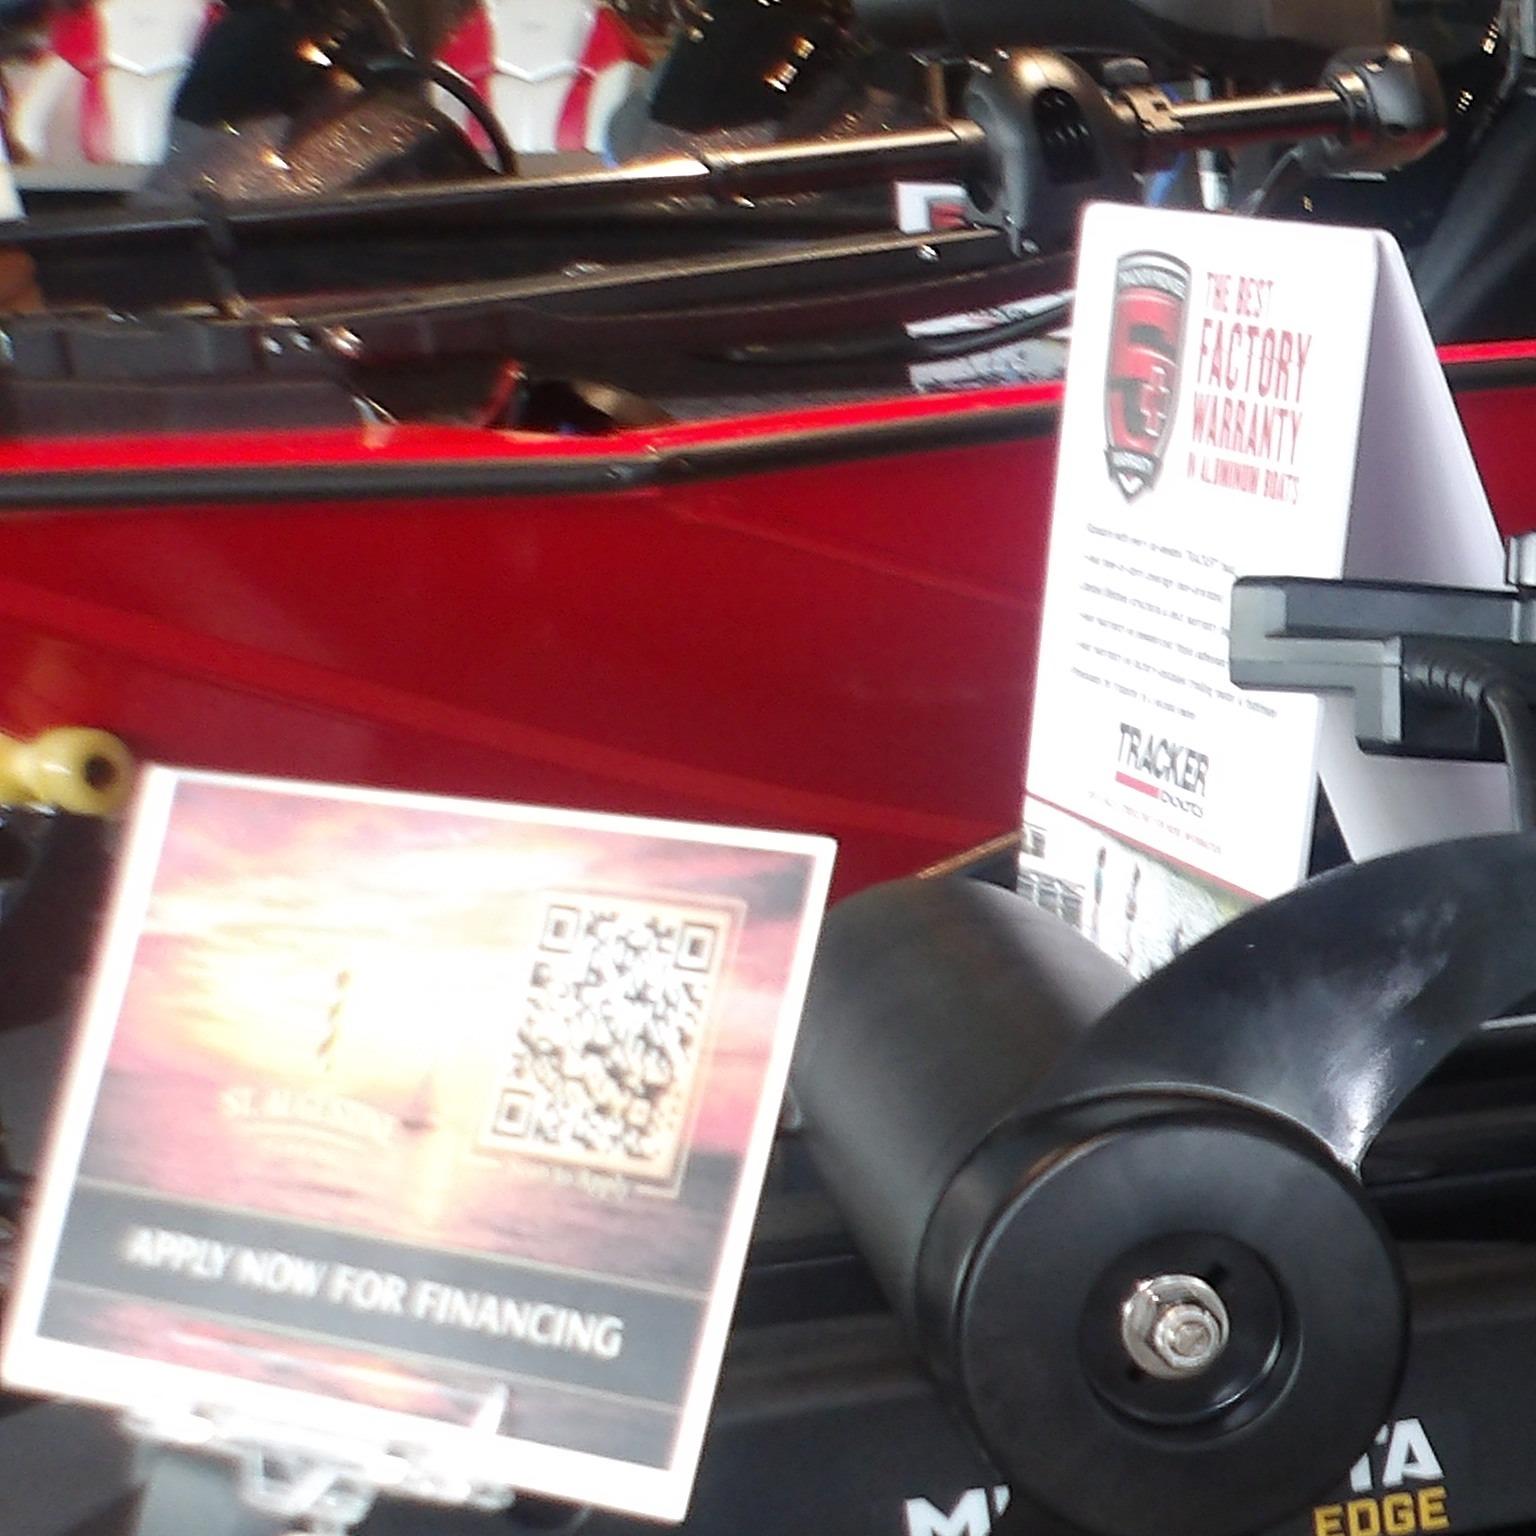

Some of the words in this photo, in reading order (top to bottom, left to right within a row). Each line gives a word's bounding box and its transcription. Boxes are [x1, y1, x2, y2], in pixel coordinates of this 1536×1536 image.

[1206, 271, 1231, 313] THE
[1236, 275, 1275, 318] BEST
[1197, 318, 1312, 403] FACTORY
[1192, 391, 1303, 465] WARRANTY
[1116, 722, 1209, 797] TRACKER
[125, 1225, 231, 1280] APPLY
[238, 1248, 327, 1297] NOW
[328, 1262, 406, 1315] FOR
[409, 1280, 625, 1360] FINANCING
